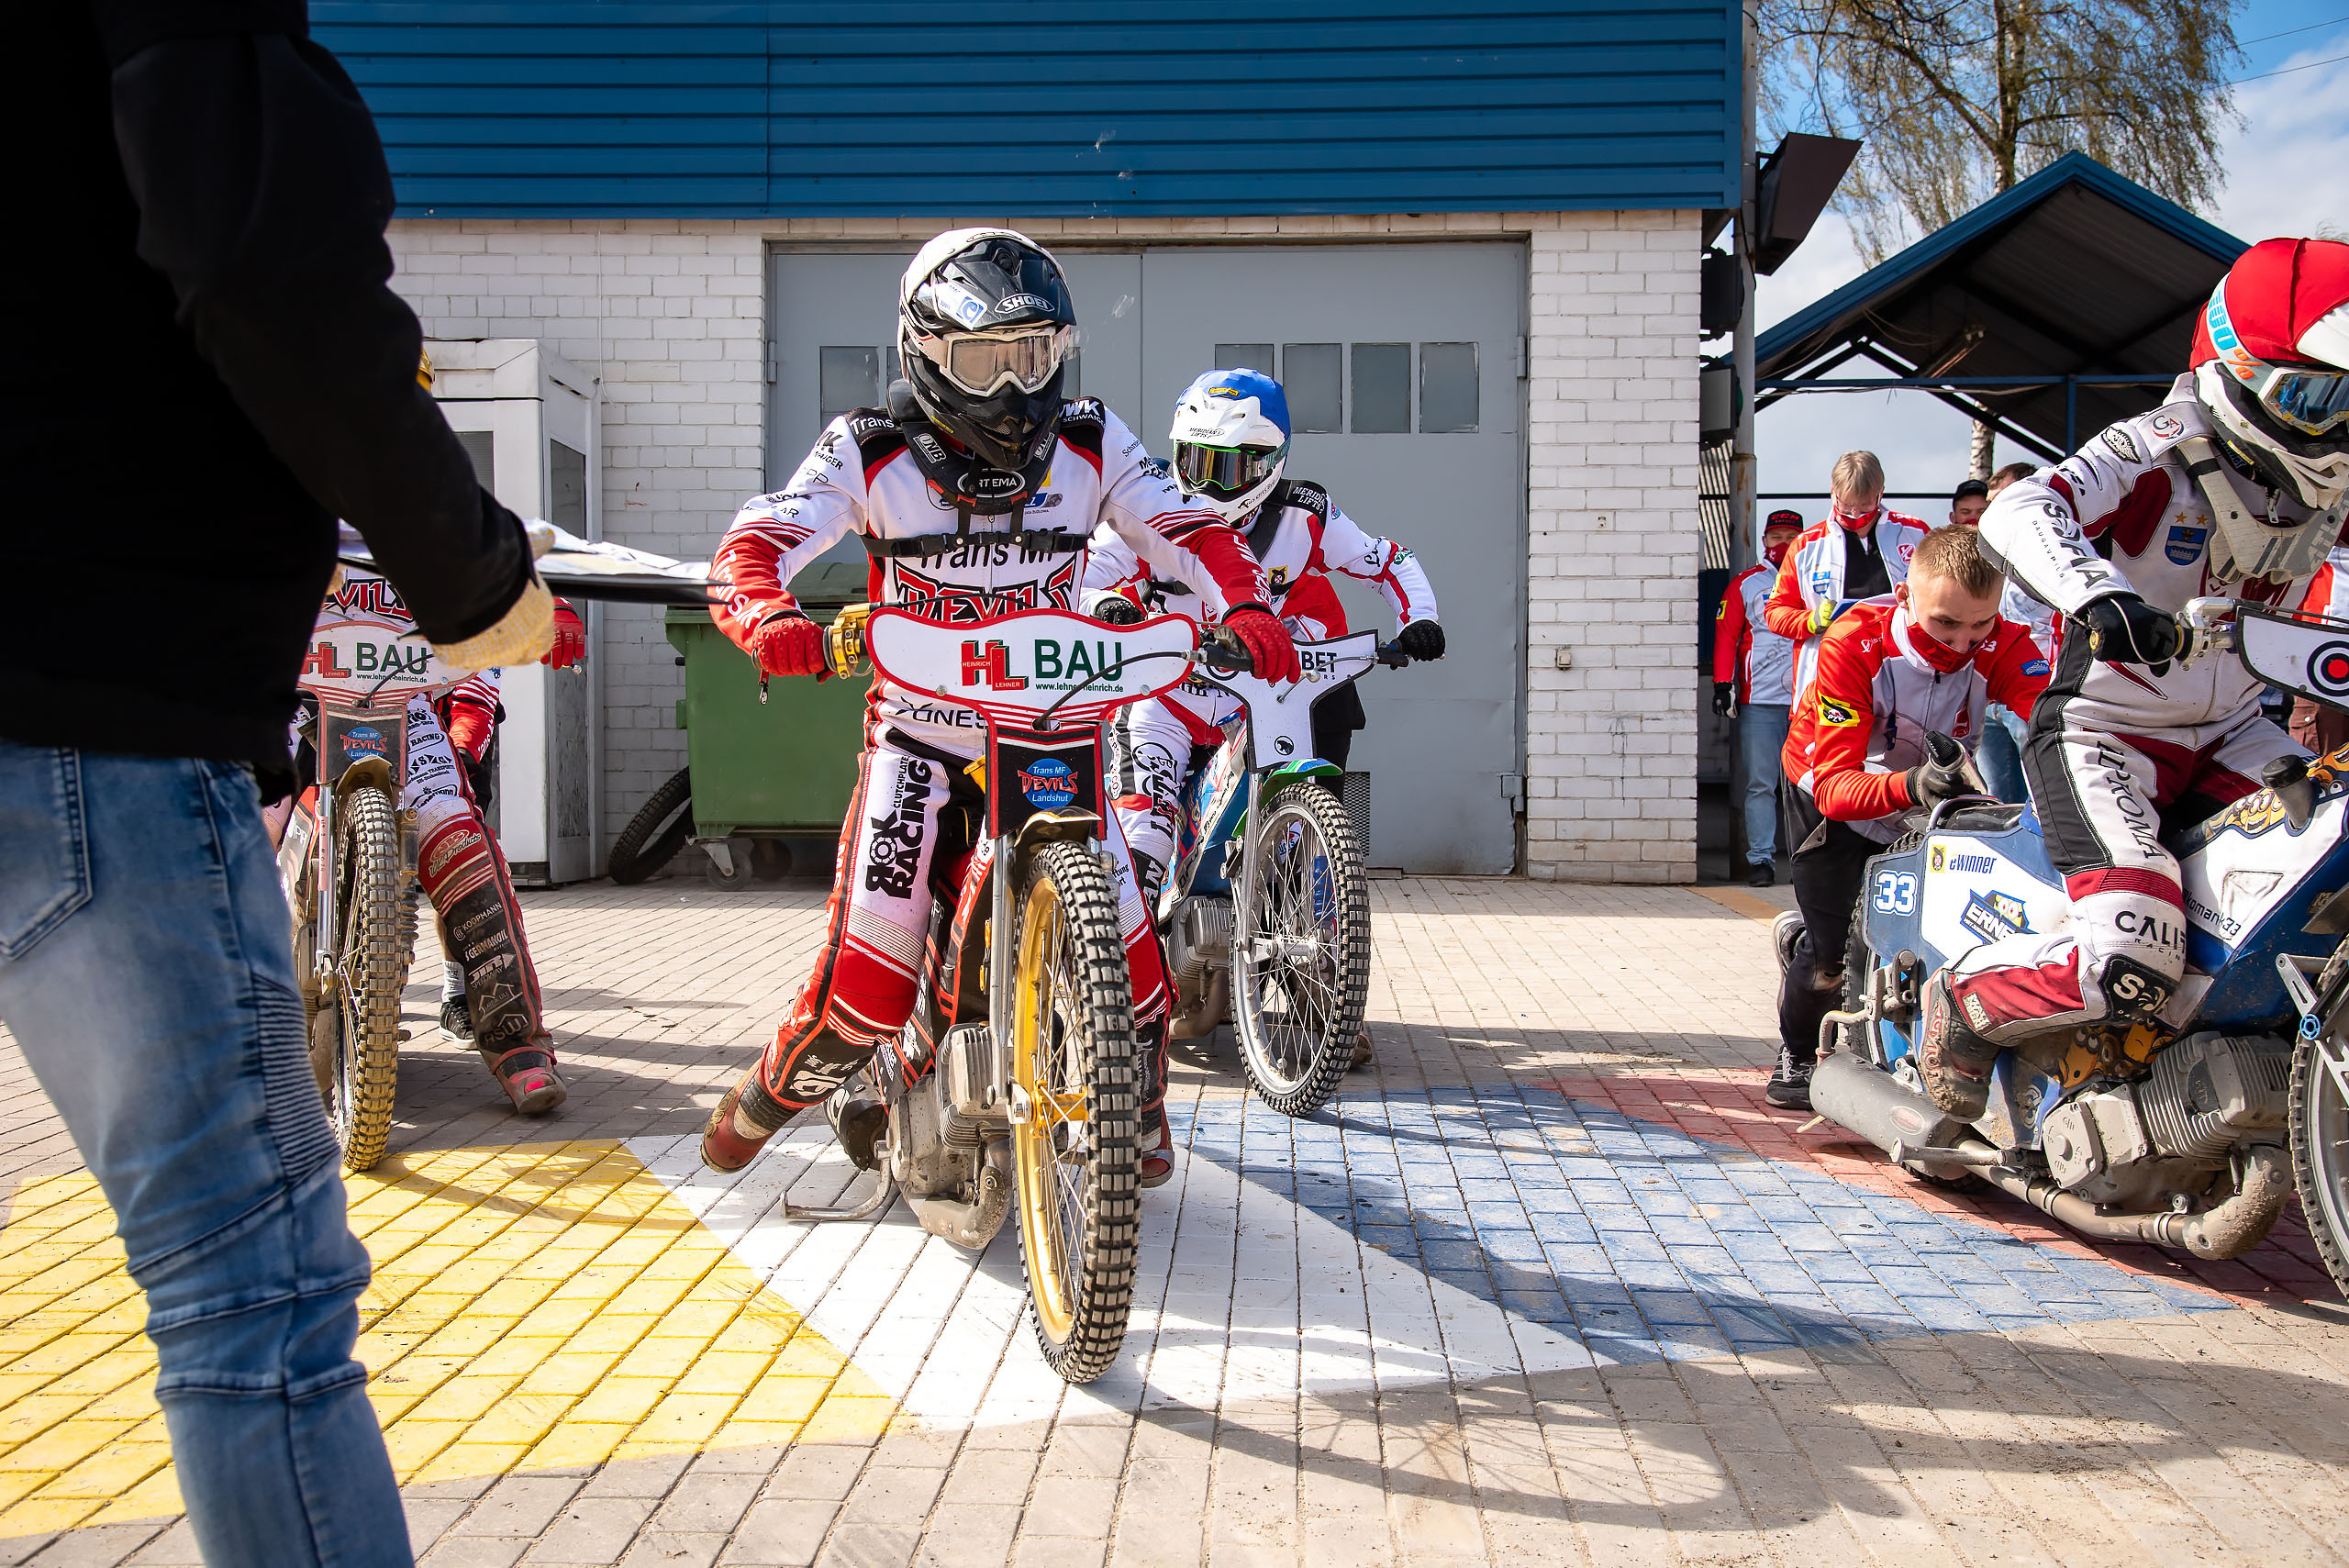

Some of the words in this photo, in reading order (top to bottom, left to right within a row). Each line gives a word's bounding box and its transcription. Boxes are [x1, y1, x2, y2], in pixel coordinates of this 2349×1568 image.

[1002, 295, 1049, 314] SHOEI
[849, 417, 896, 436] Trans
[356, 642, 428, 675] BAU
[1034, 639, 1124, 682] BAU
[340, 734, 387, 752] DEVILS
[410, 733, 440, 747] RACING
[1018, 770, 1078, 795] DEVILS
[1033, 766, 1053, 774] Trans
[1054, 766, 1066, 774] MF
[1032, 794, 1068, 803] Landshut
[888, 759, 933, 899] RACING
[444, 832, 482, 863] Products
[1873, 870, 1918, 917] 33
[462, 902, 503, 932] KOOPMANN
